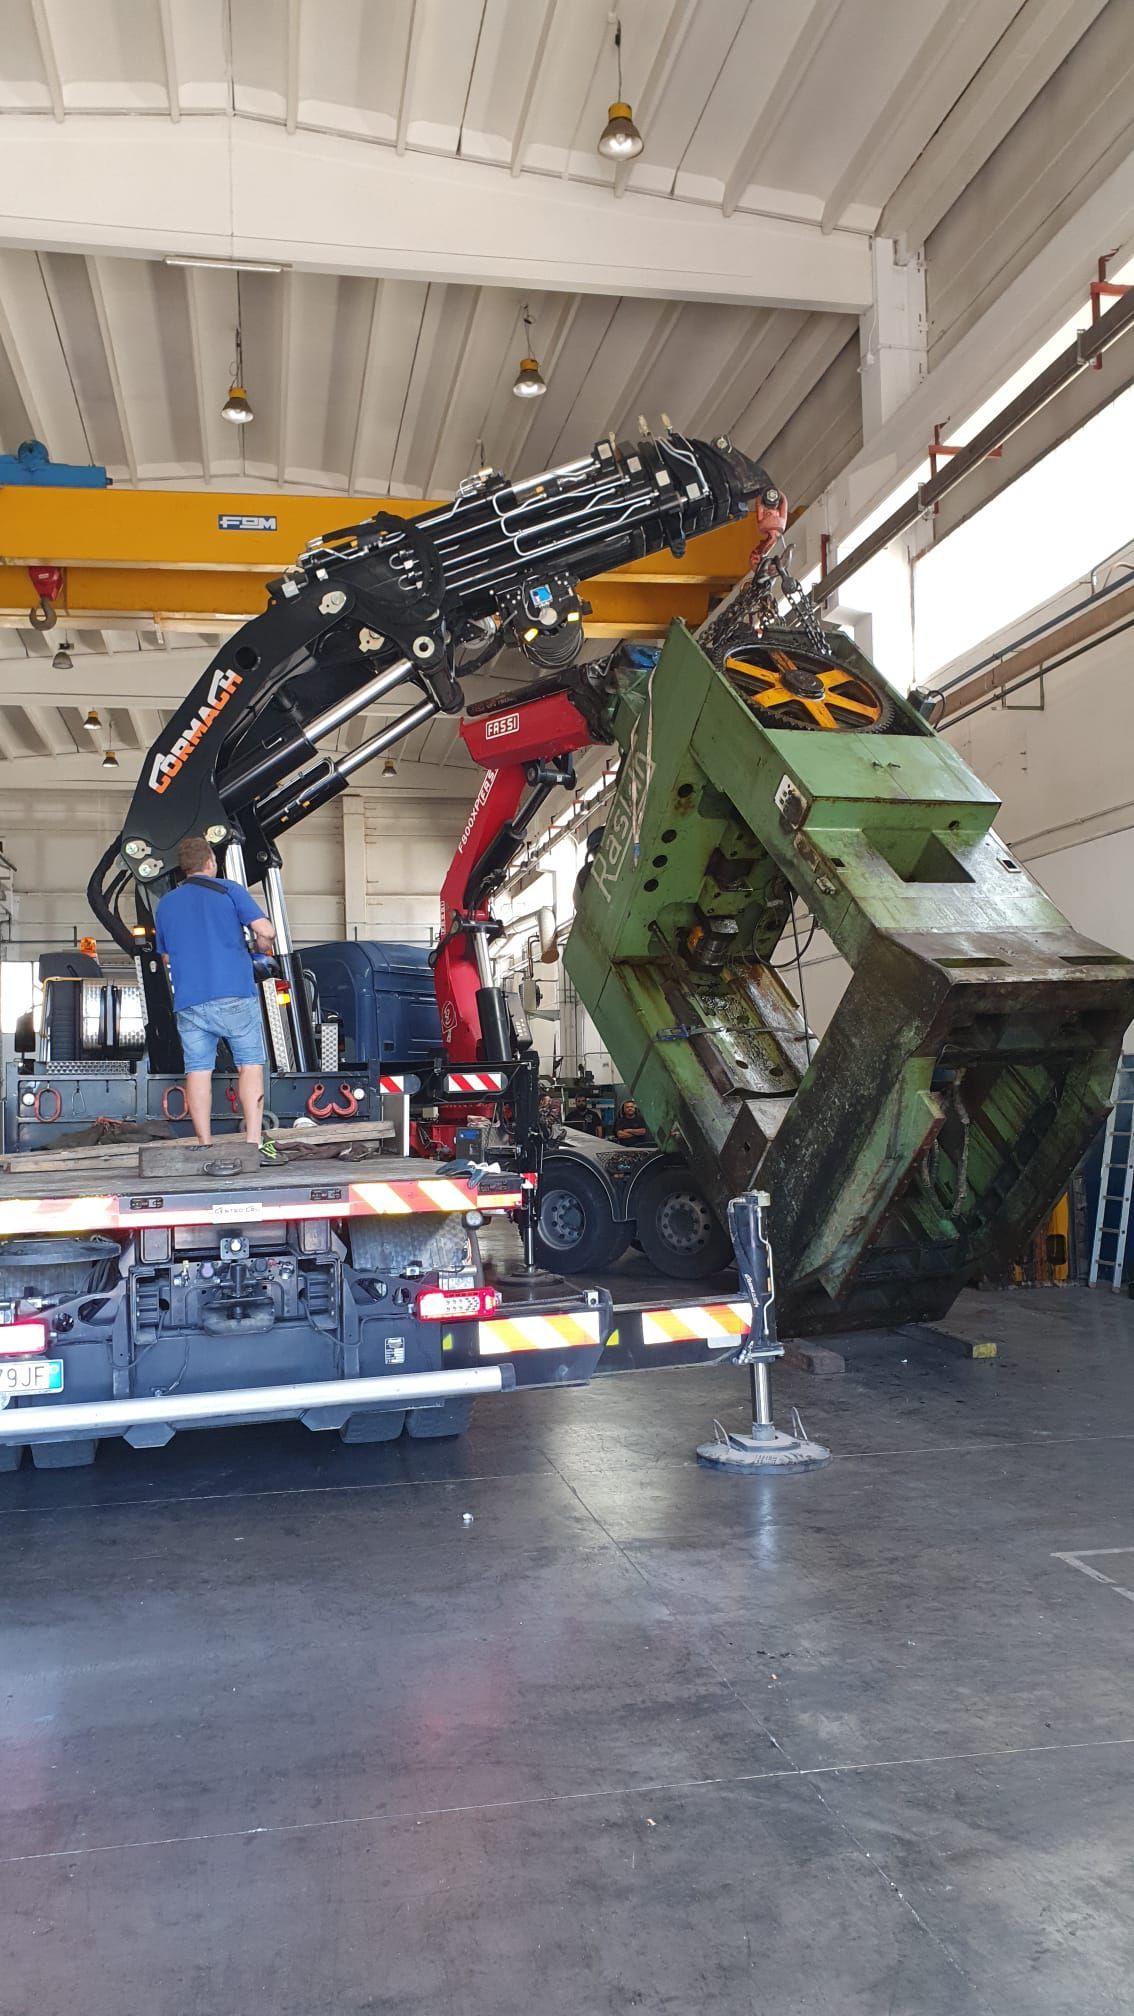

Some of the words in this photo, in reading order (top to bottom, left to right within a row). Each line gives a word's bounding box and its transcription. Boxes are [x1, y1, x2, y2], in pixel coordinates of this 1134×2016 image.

[148, 668, 244, 795] CORMACH
[487, 716, 517, 737] FASSI
[458, 799, 481, 855] F800XP
[0, 1365, 45, 1388] 9JF
